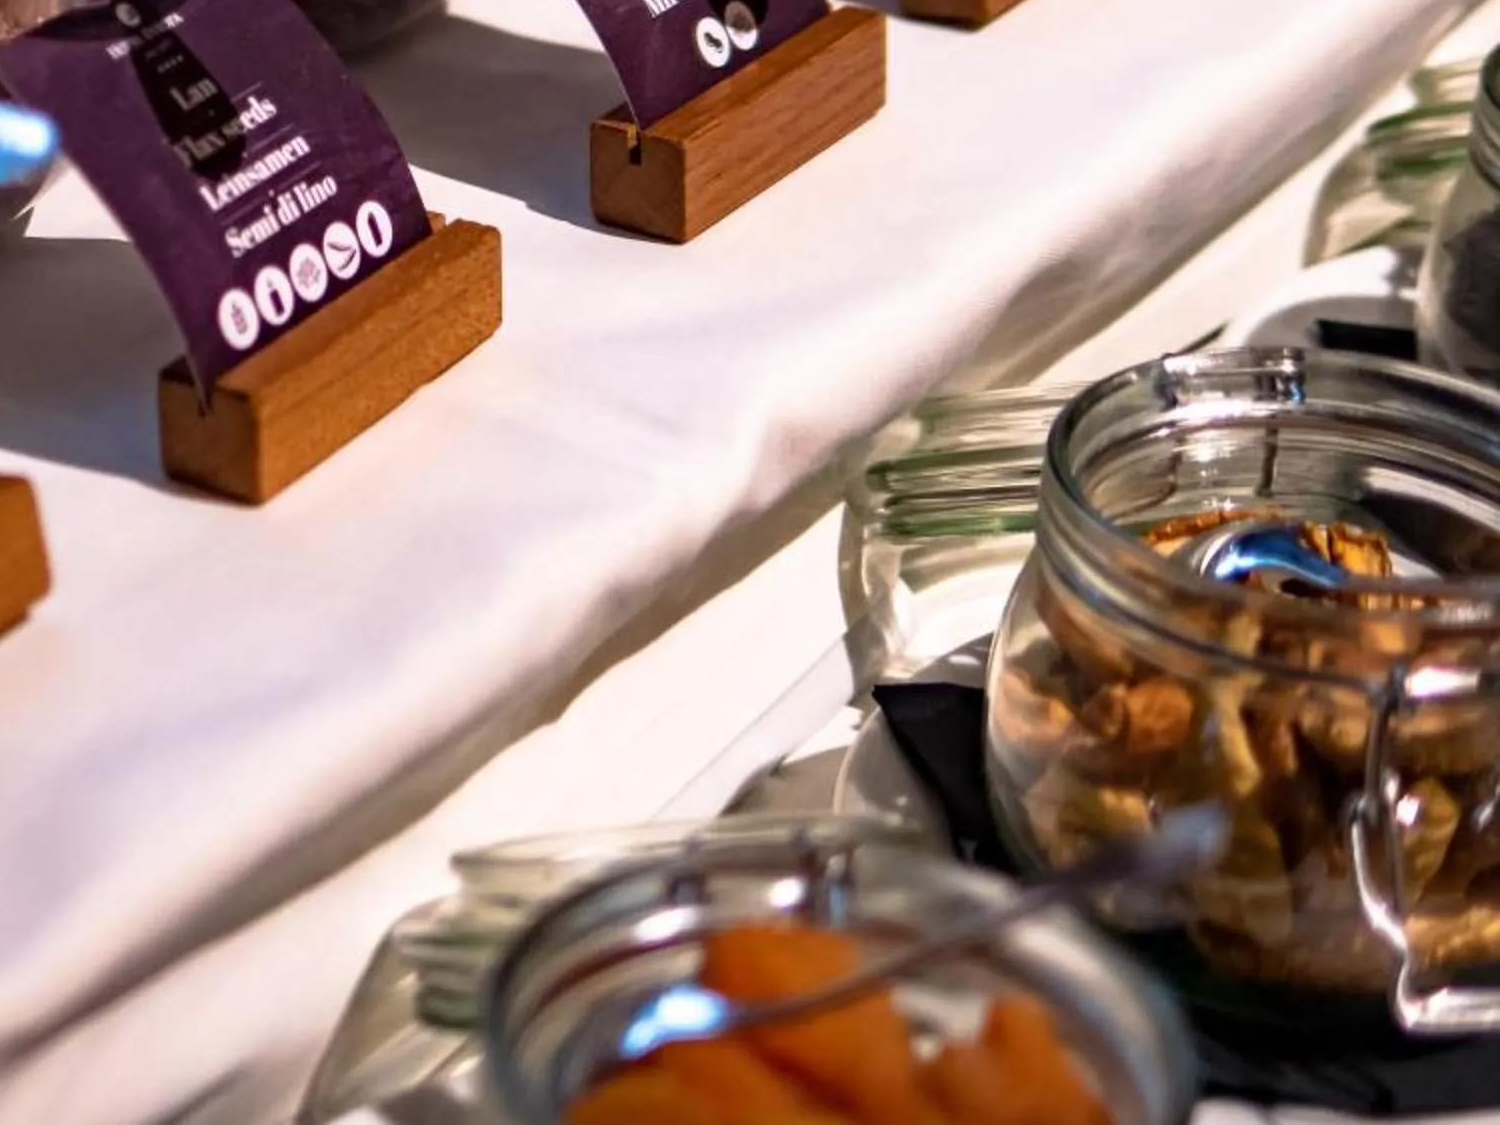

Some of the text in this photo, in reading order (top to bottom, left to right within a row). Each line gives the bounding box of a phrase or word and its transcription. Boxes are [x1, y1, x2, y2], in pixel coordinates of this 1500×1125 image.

[169, 78, 219, 111] Lan
[220, 94, 278, 140] seeds
[199, 134, 310, 213] Leinsamen
[225, 176, 338, 259] Semi di lino
